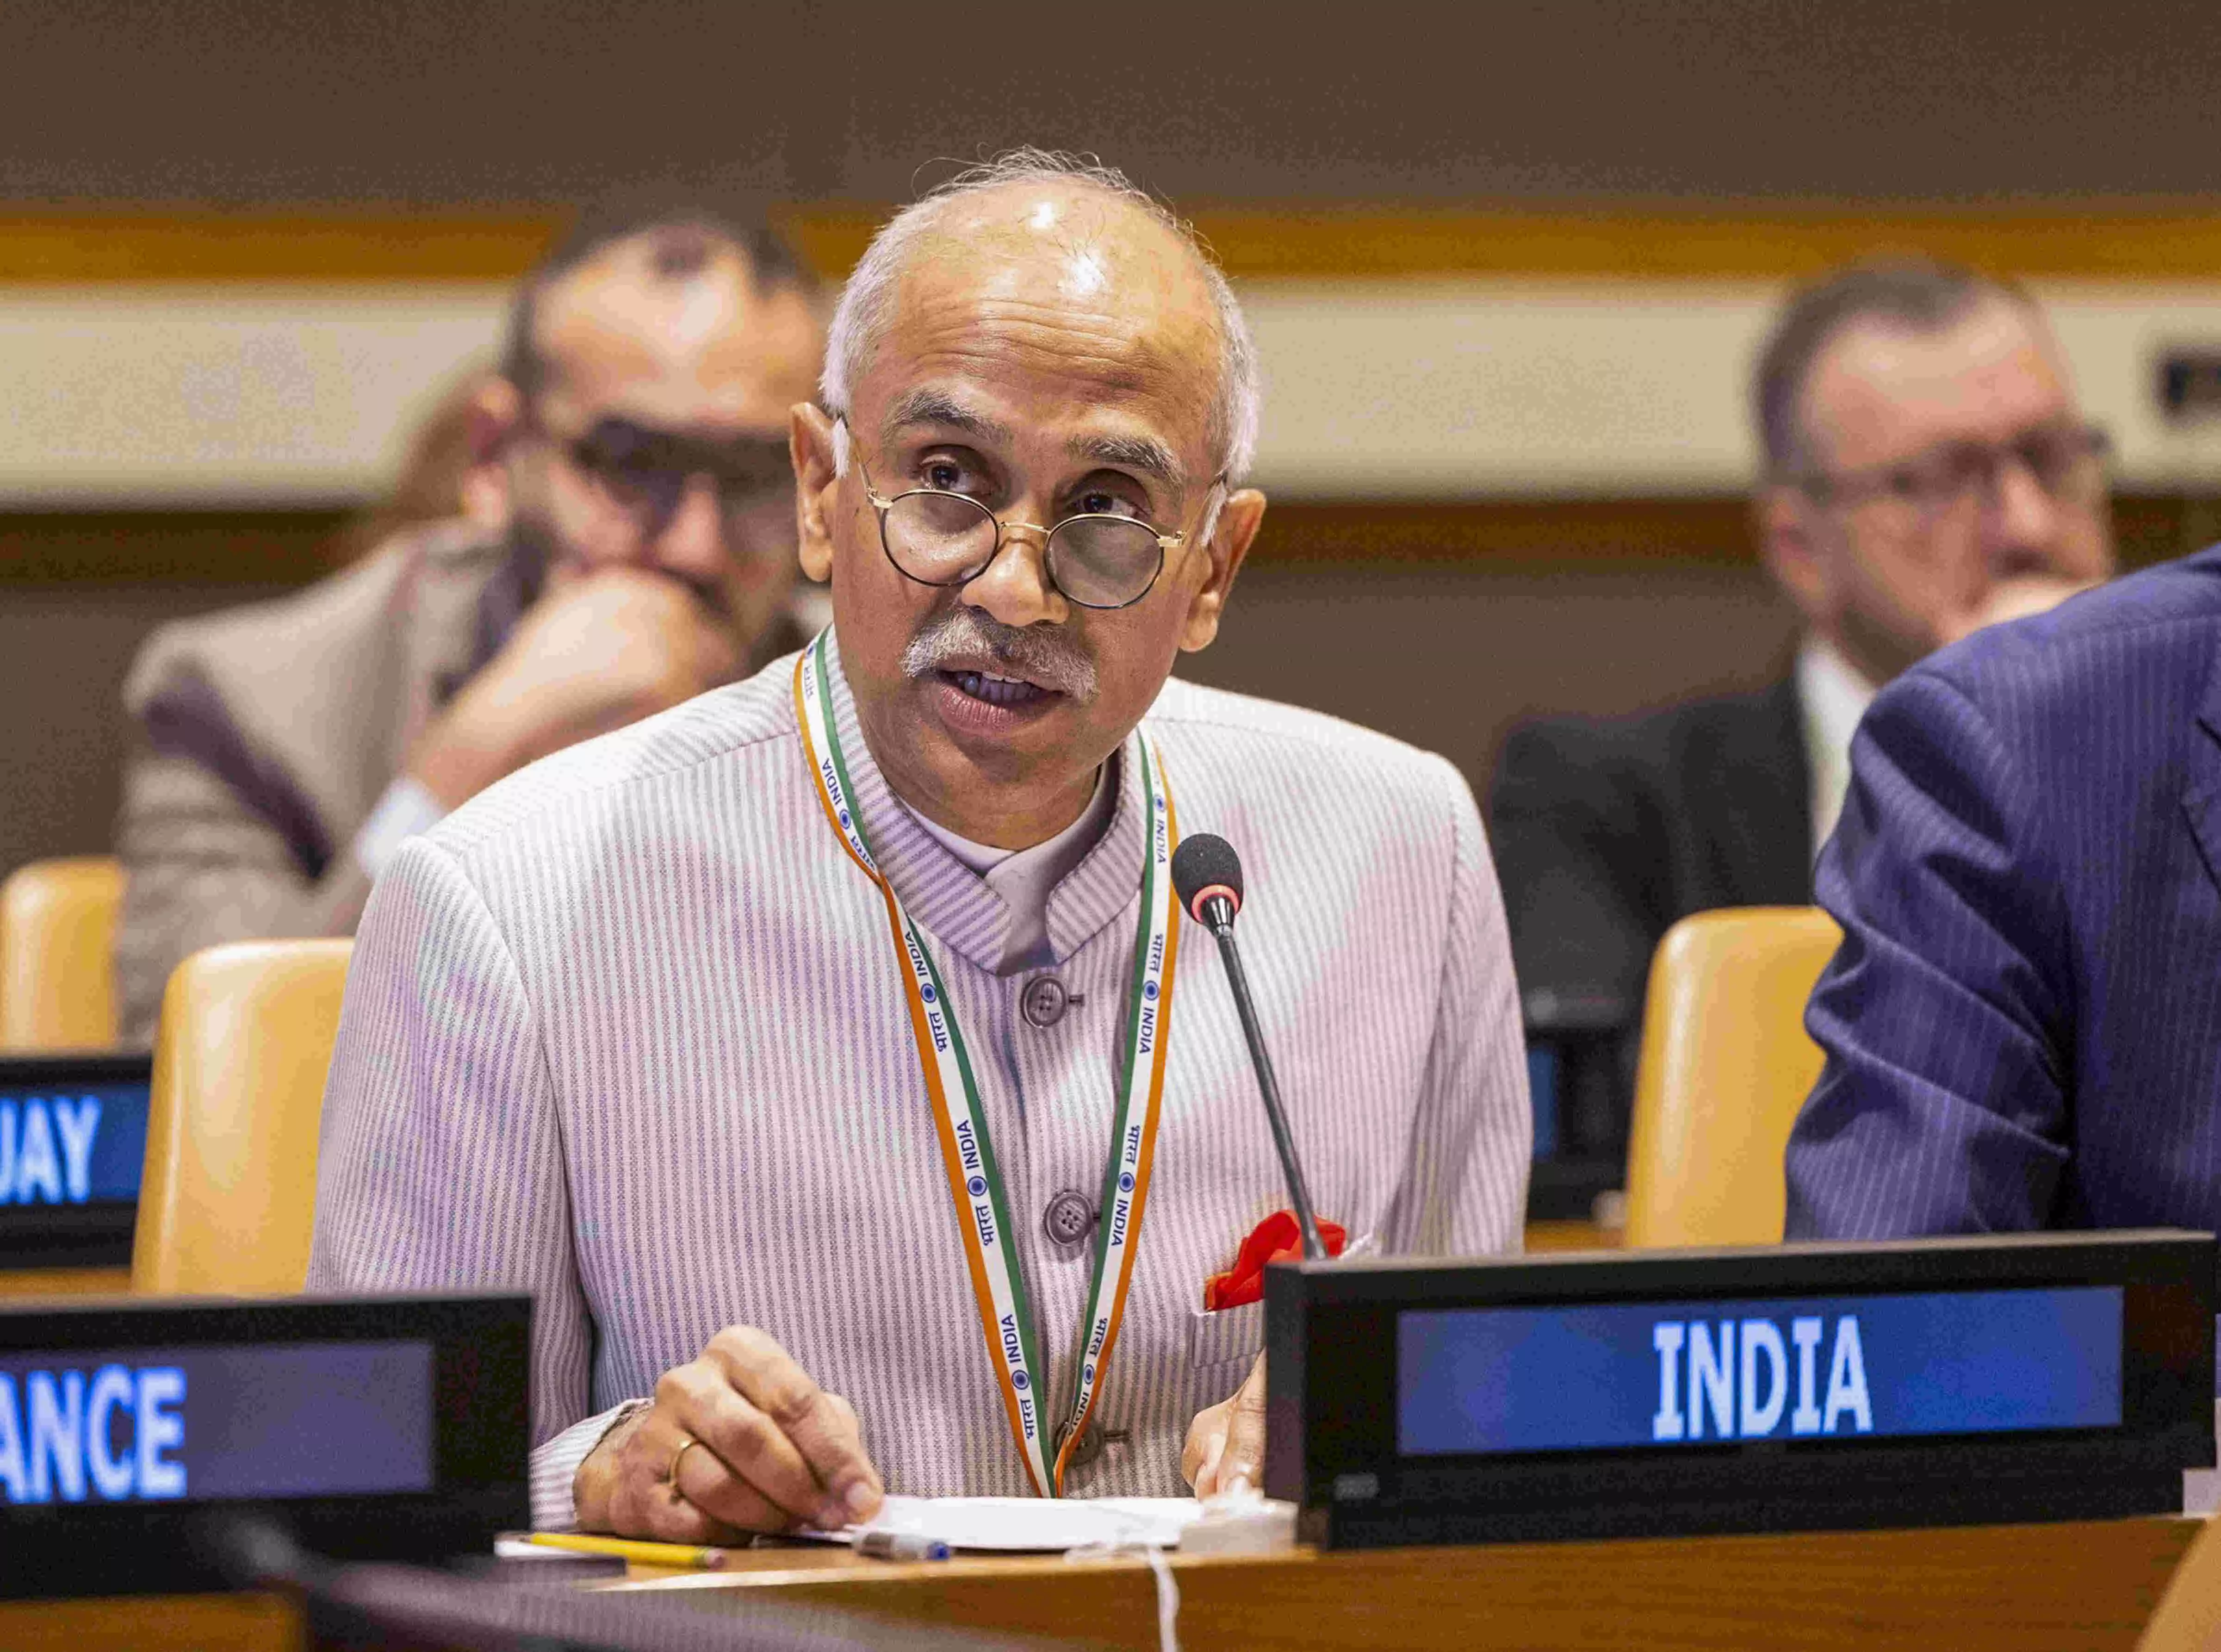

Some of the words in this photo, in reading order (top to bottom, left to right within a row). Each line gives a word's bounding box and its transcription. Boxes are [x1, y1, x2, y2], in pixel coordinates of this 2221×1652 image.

[822, 758, 842, 805] INDIA
[1156, 819, 1166, 863] INDIA
[905, 931, 928, 976] INDIA
[1149, 933, 1163, 973] भारत
[929, 1012, 947, 1052] भारत
[1139, 1007, 1154, 1054] INDIA
[957, 1119, 980, 1169] INDIA
[1125, 1125, 1140, 1165] भारत
[976, 1205, 994, 1246] भारत
[1111, 1199, 1129, 1247] INDIA
[1000, 1314, 1020, 1363] INDIA
[1089, 1318, 1108, 1357] भारत
[1653, 1314, 1873, 1441] INDIA
[1020, 1399, 1034, 1440] भारत
